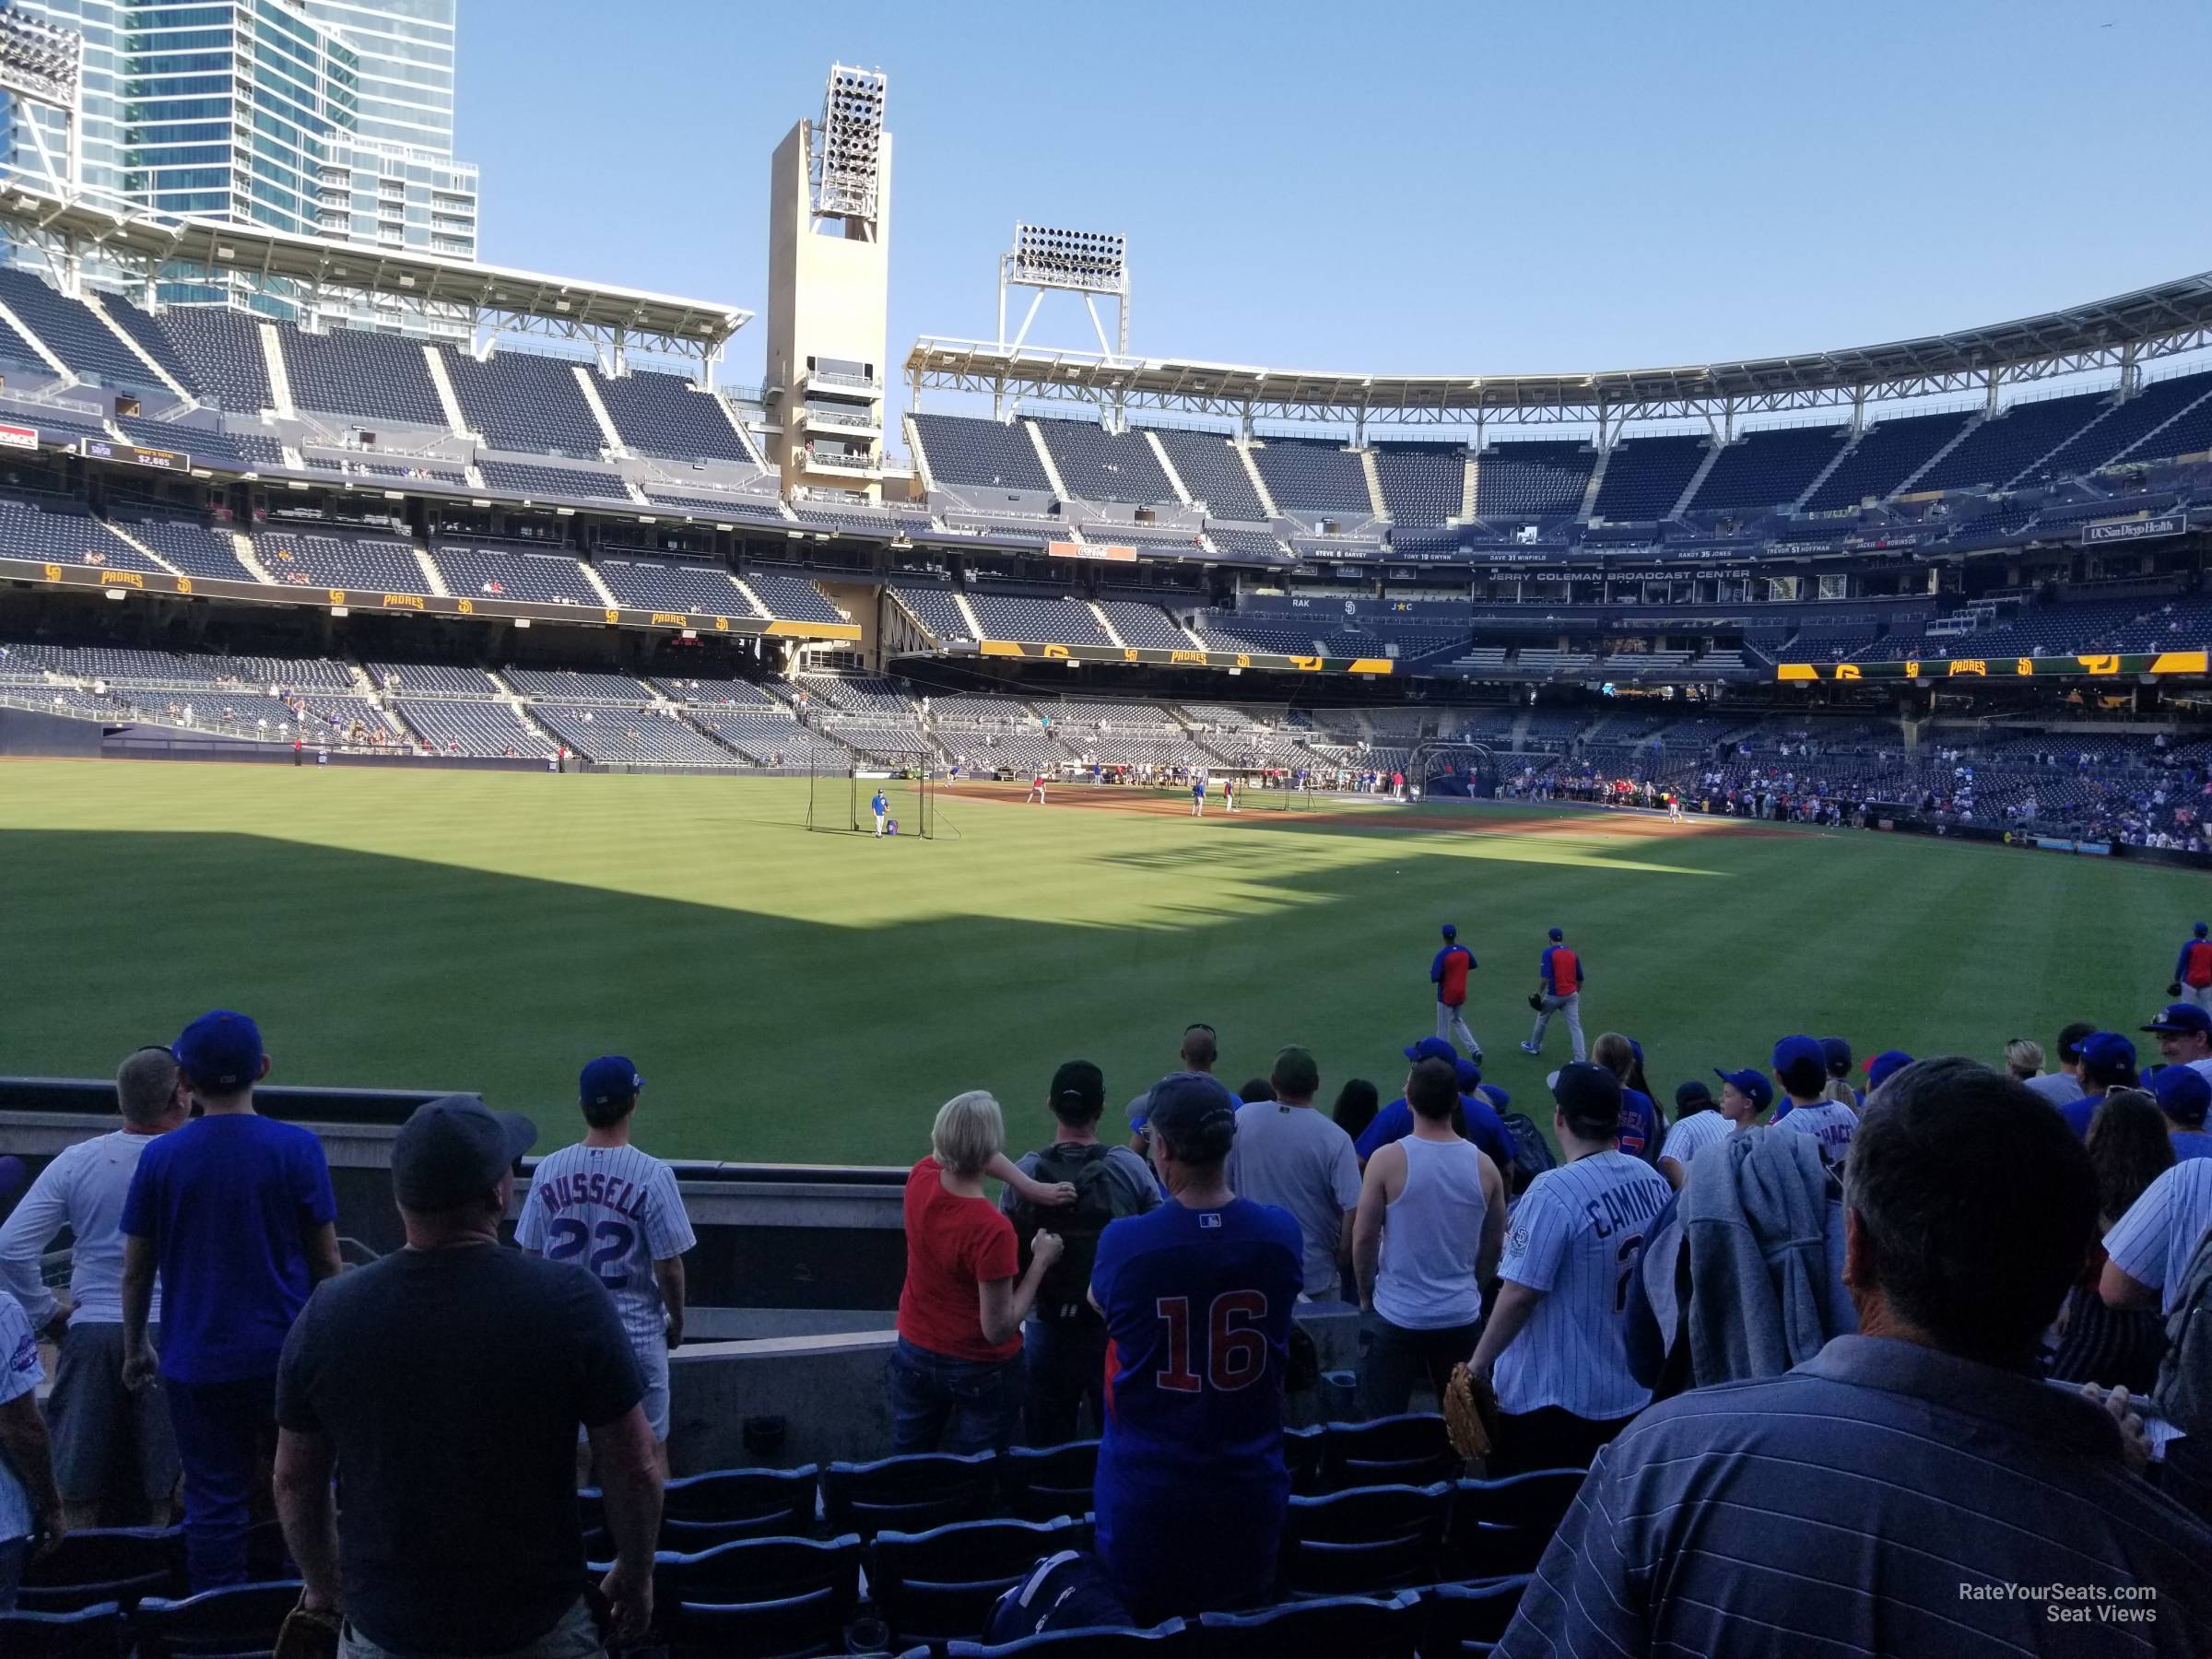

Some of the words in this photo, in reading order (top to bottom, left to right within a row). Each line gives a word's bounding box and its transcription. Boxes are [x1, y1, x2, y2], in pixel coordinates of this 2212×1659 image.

[2091, 528, 2105, 538] UC
[2105, 526, 2121, 536] San
[2121, 525, 2145, 536] Diego
[2146, 521, 2173, 533] Health
[1801, 545, 1830, 553] HOFFMAN
[1856, 541, 1877, 549] JACKIE
[1887, 538, 1917, 547] ROBINSON
[100, 571, 144, 589] PADRES
[1488, 572, 1531, 581] JERRY
[1536, 572, 1602, 581] COLEMAN
[1606, 571, 1691, 581] BROADCAST
[1696, 570, 1750, 579] CENTER
[382, 594, 424, 609] PADRES
[1292, 599, 1310, 607] RAK
[651, 613, 687, 627] PADRES
[1171, 651, 1207, 665] PADRES
[1948, 659, 1986, 677] PADRES
[539, 1172, 648, 1221] RUSSELL
[550, 1218, 636, 1289] 22
[1156, 1289, 1268, 1393] 16
